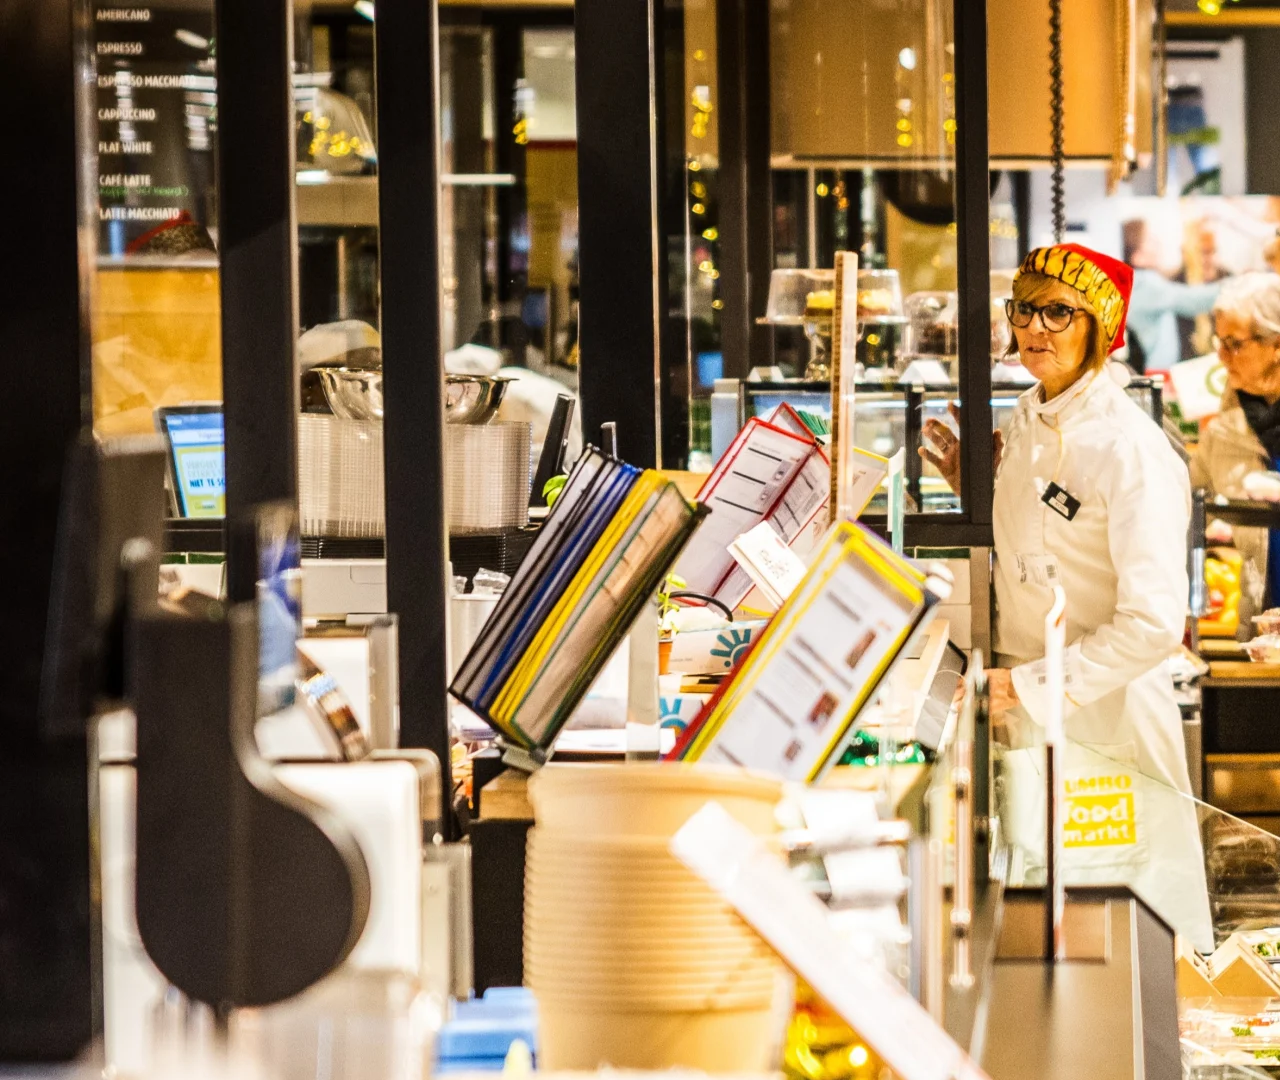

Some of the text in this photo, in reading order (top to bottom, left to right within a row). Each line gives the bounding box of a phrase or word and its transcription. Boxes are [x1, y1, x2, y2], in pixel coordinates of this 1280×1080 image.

[97, 8, 151, 21] AMERICANO
[97, 42, 143, 55] ESPRESSO
[98, 75, 143, 88] ESPSO
[98, 108, 156, 121] CAPPUCCINO
[99, 141, 152, 154] FLAT WHITE
[124, 174, 151, 187] LATTE
[101, 207, 181, 220] LATTE MACCHIATO
[1063, 774, 1132, 794] UMBO
[1063, 797, 1129, 824] food
[1063, 824, 1130, 842] markt
